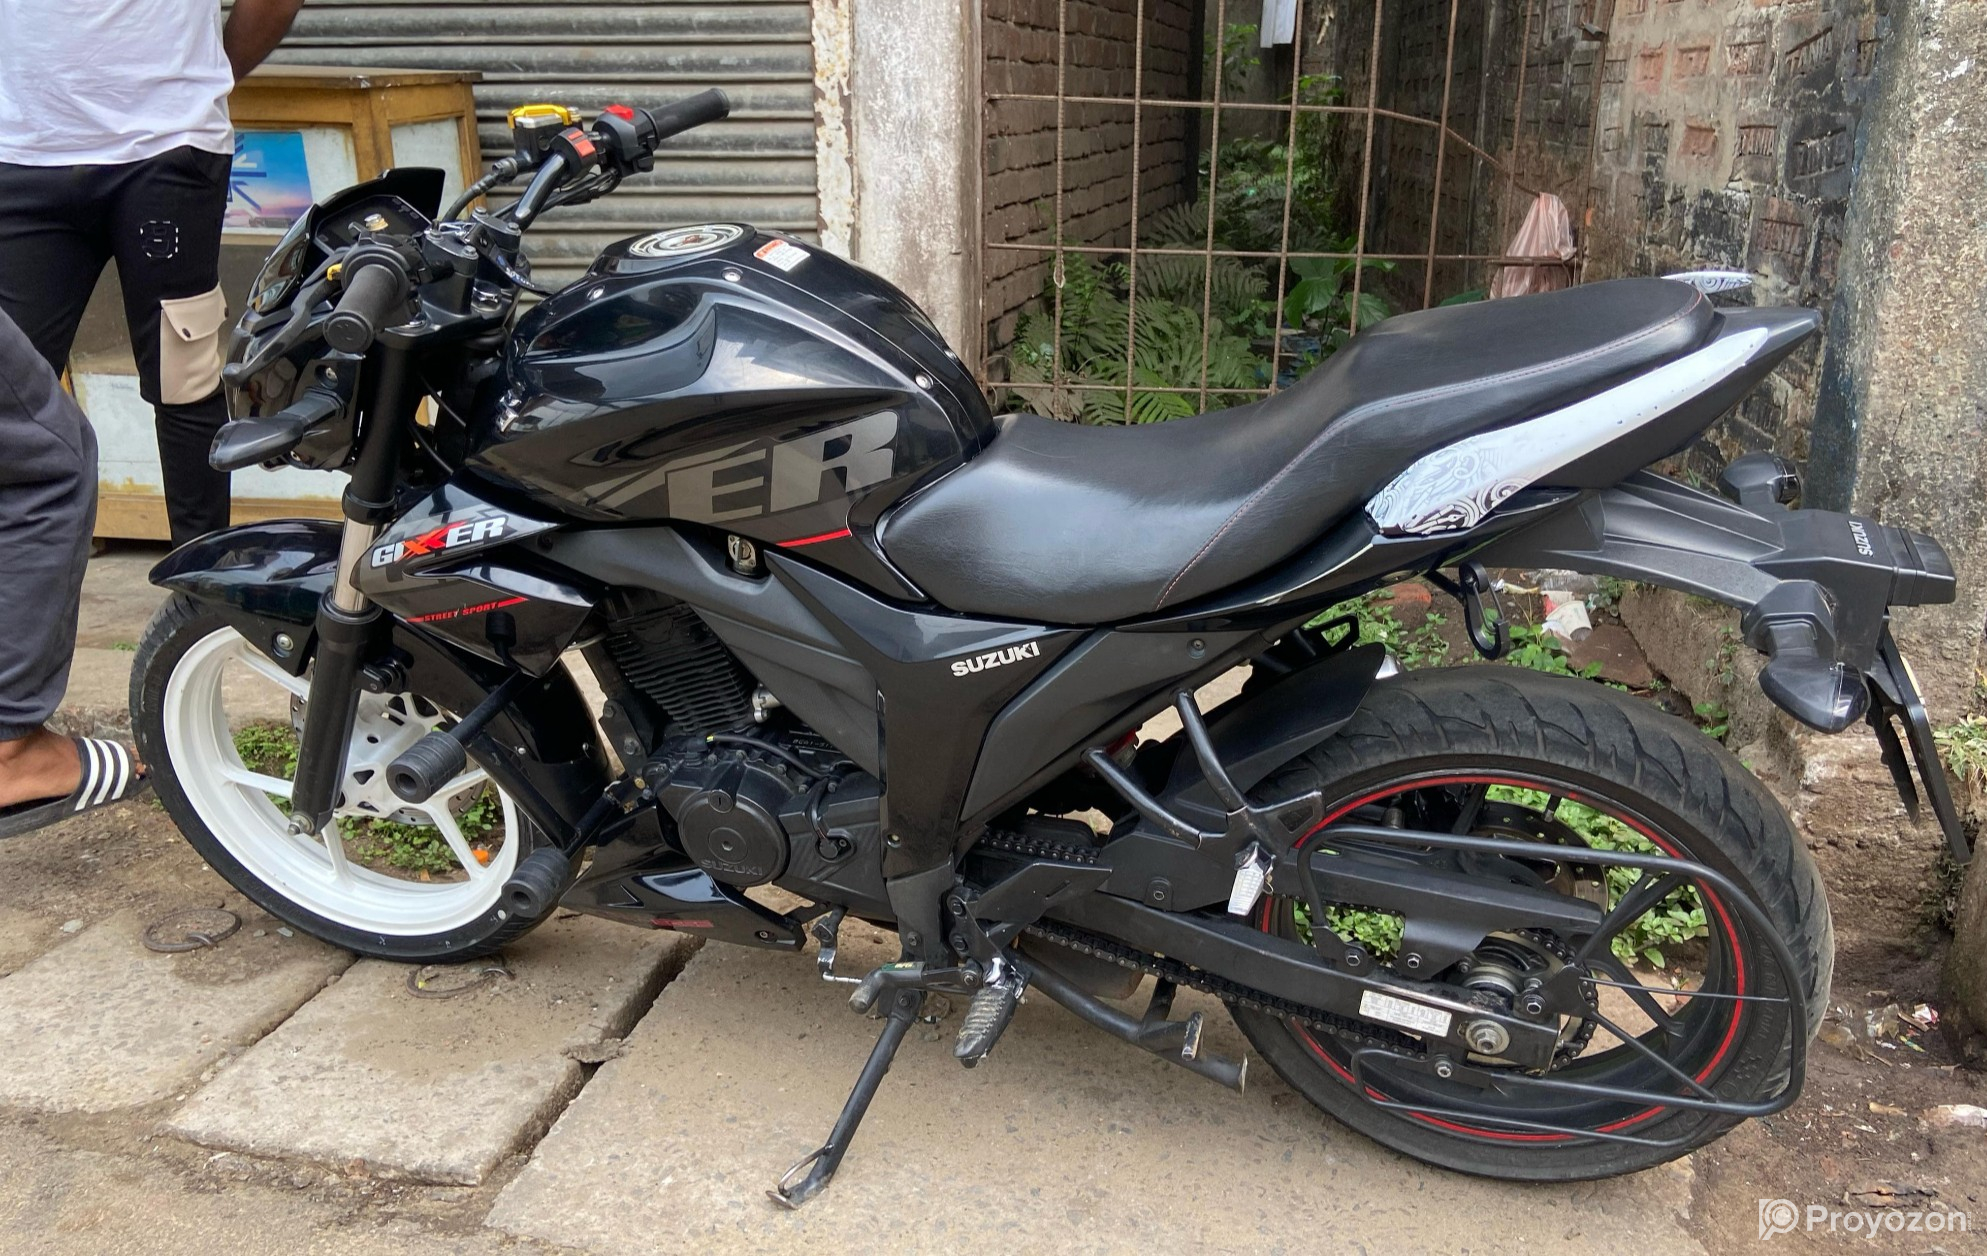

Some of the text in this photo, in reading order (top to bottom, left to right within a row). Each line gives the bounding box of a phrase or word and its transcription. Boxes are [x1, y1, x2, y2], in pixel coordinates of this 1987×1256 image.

[1849, 520, 1874, 557] SUZUKI
[424, 602, 498, 622] STREET SPORT
[950, 641, 1041, 677] SUZUKI
[701, 859, 763, 876] SUZUKI
